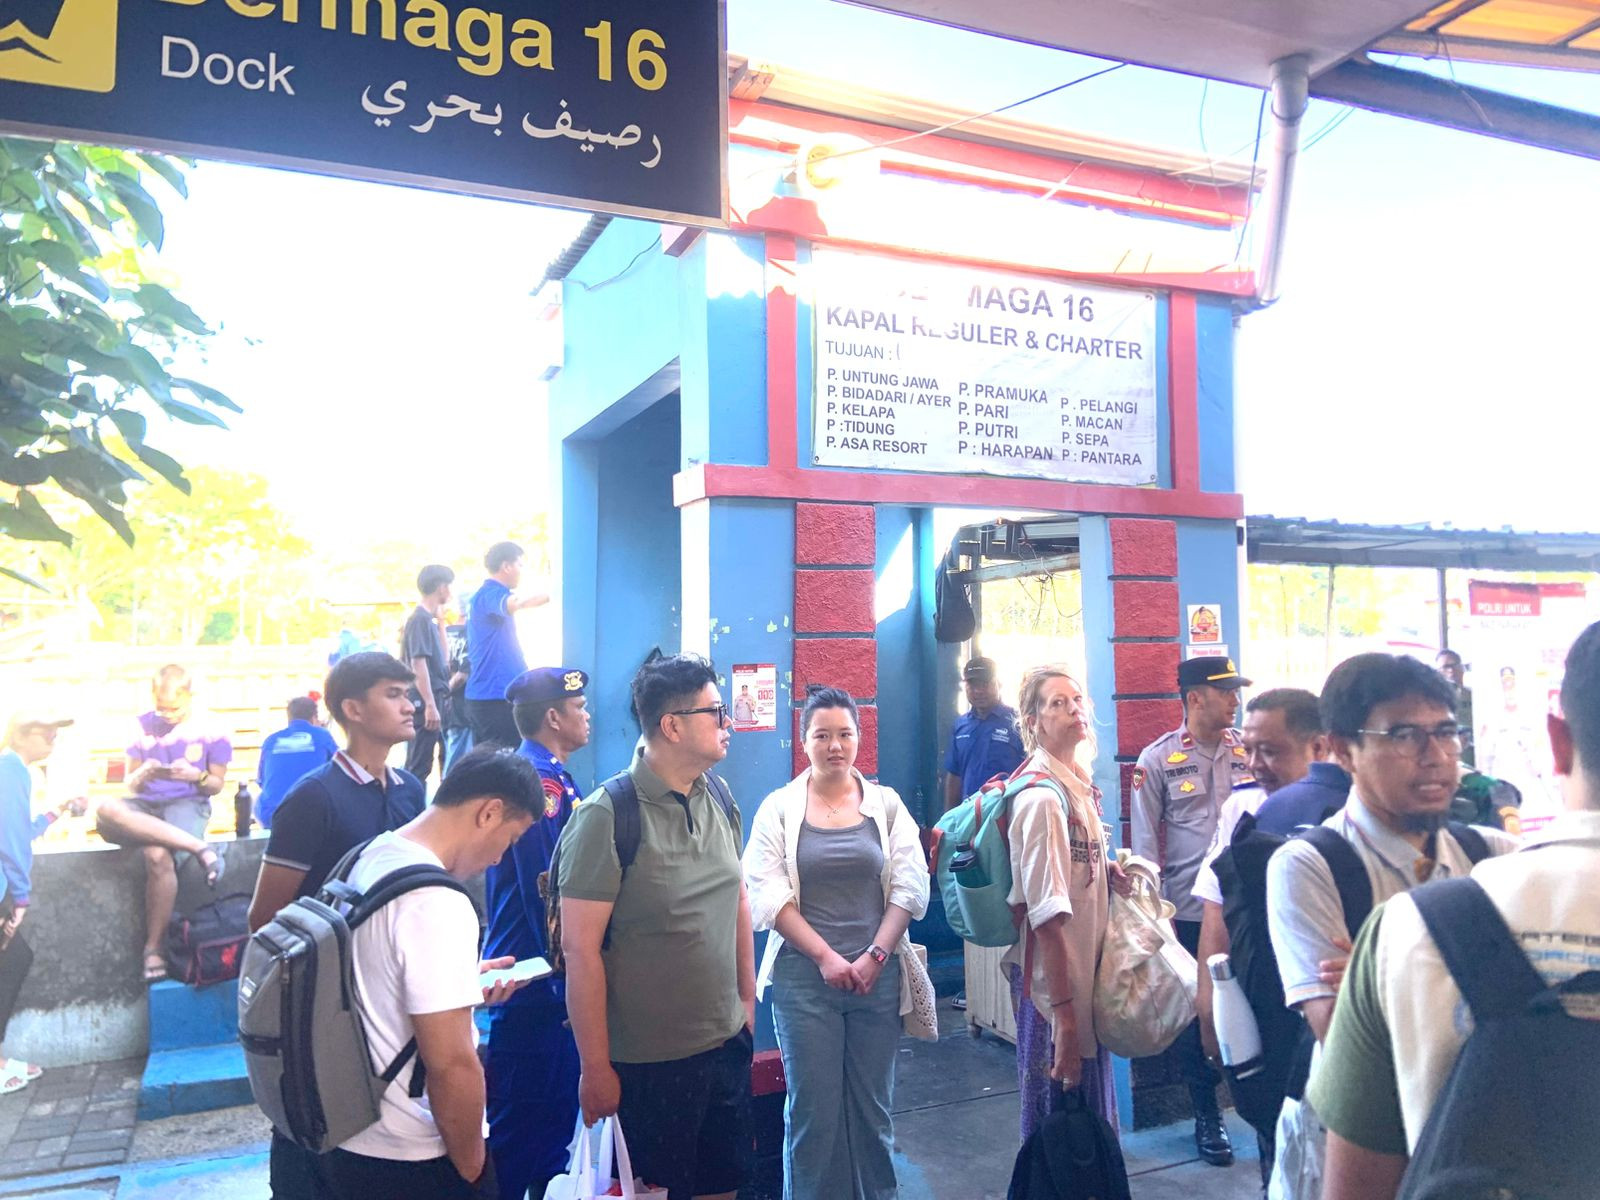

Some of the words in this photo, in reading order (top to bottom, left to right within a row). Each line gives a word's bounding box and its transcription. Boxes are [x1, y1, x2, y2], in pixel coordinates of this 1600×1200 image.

[160, 0, 553, 76] maga
[584, 20, 667, 91] 16
[161, 35, 295, 95] Dock
[361, 80, 502, 136] بحري
[522, 99, 662, 168] رصيف
[1063, 294, 1094, 322] 16
[827, 306, 904, 334] KAPAL
[1026, 331, 1038, 349] &
[1046, 333, 1142, 359] CHARTER
[826, 341, 884, 359] TUJUAN
[827, 368, 837, 381] P.
[842, 370, 898, 387] UNTUNG
[902, 376, 939, 390] JAWA
[827, 385, 837, 398] P.
[842, 387, 906, 404] BIDADARI
[918, 394, 951, 407] AYER
[959, 382, 970, 396] P.
[975, 384, 1047, 404] PRAMUKA
[827, 402, 837, 414] P.
[842, 404, 895, 419] KELAPA
[958, 402, 970, 416] P.
[975, 403, 1008, 419] PARI
[1081, 399, 1138, 414] PELANGI
[958, 422, 970, 435] P.
[975, 423, 1018, 439] PUTRI
[1061, 415, 1072, 427] P.
[1076, 416, 1122, 430] MACAN
[826, 436, 837, 448] P.
[841, 437, 869, 450] ASA
[873, 439, 927, 454] RESORT
[1062, 432, 1073, 444] P.
[1076, 433, 1109, 447] SEPA
[981, 442, 1052, 461] HARAPAN
[1081, 451, 1141, 465] PANTARA
[1505, 603, 1532, 614] UNTUK
